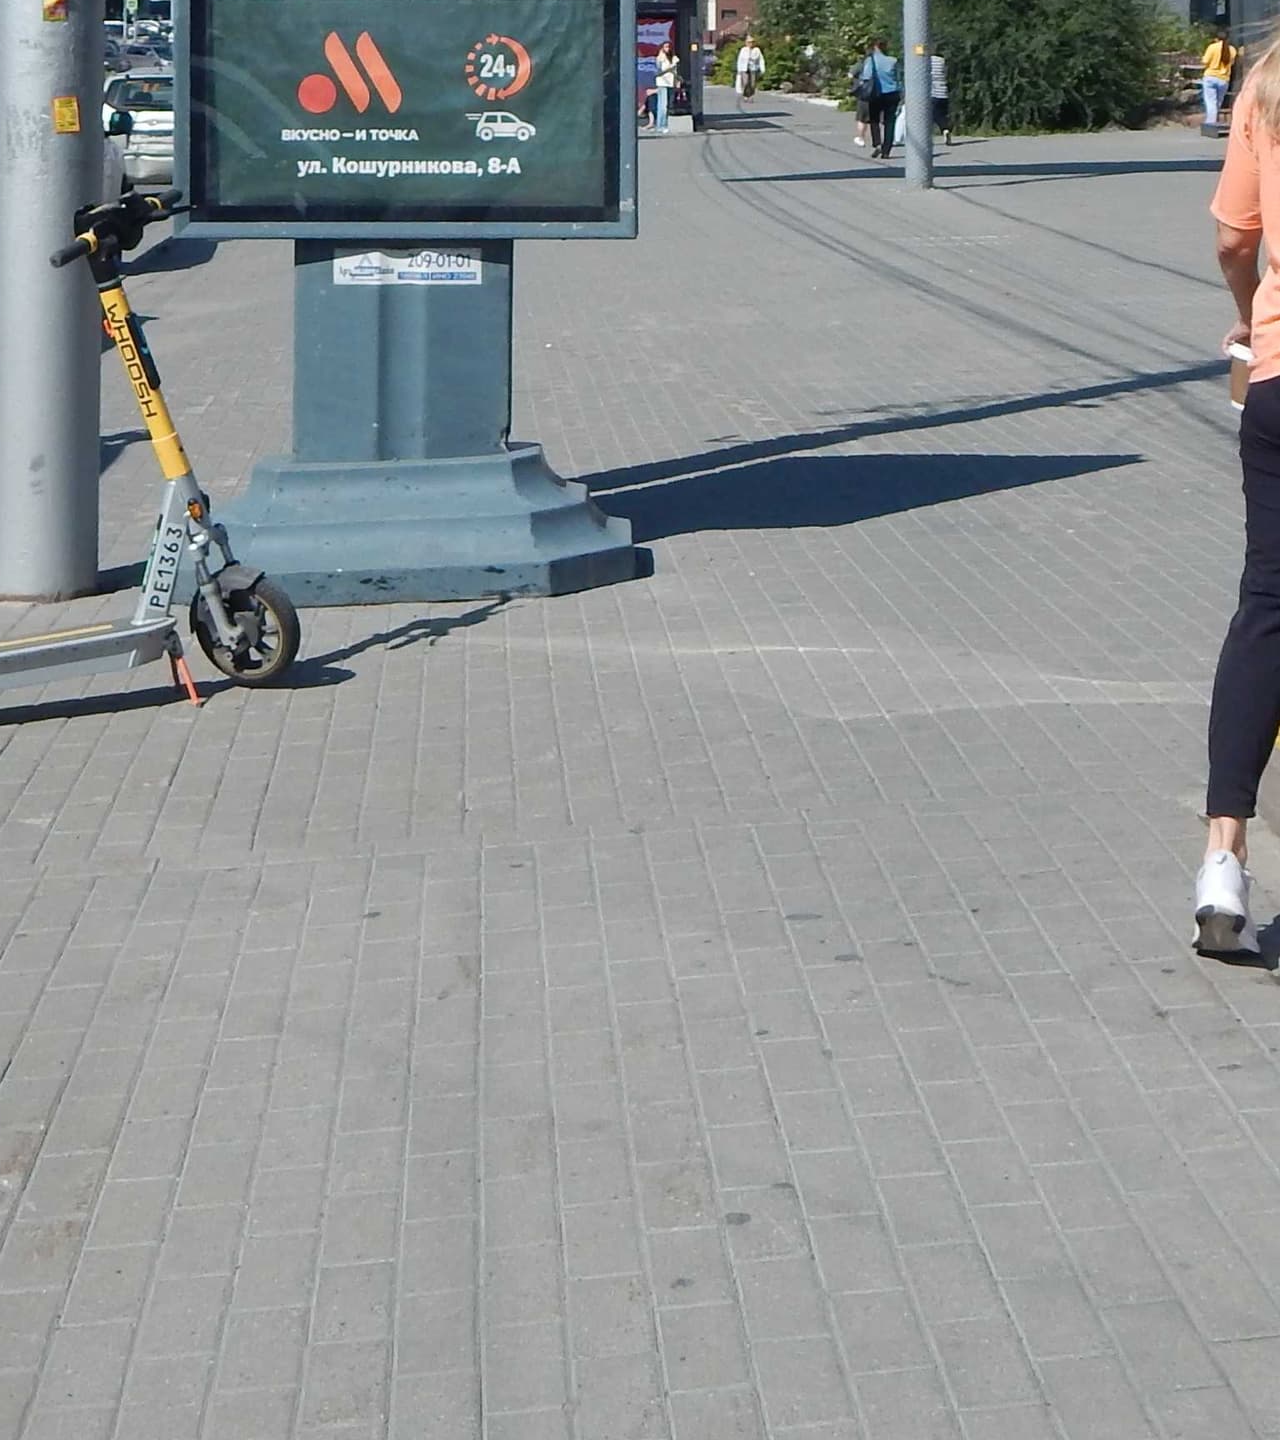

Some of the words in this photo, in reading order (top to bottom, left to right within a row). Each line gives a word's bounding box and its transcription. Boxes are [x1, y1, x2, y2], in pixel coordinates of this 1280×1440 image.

[281, 129, 341, 142] ВКУСНО
[369, 129, 419, 142] ТОЧКА
[297, 159, 327, 177] ул.
[332, 157, 484, 177] Кошурникова,
[407, 253, 472, 269] 209-01-01
[106, 302, 158, 419] WHOOSH
